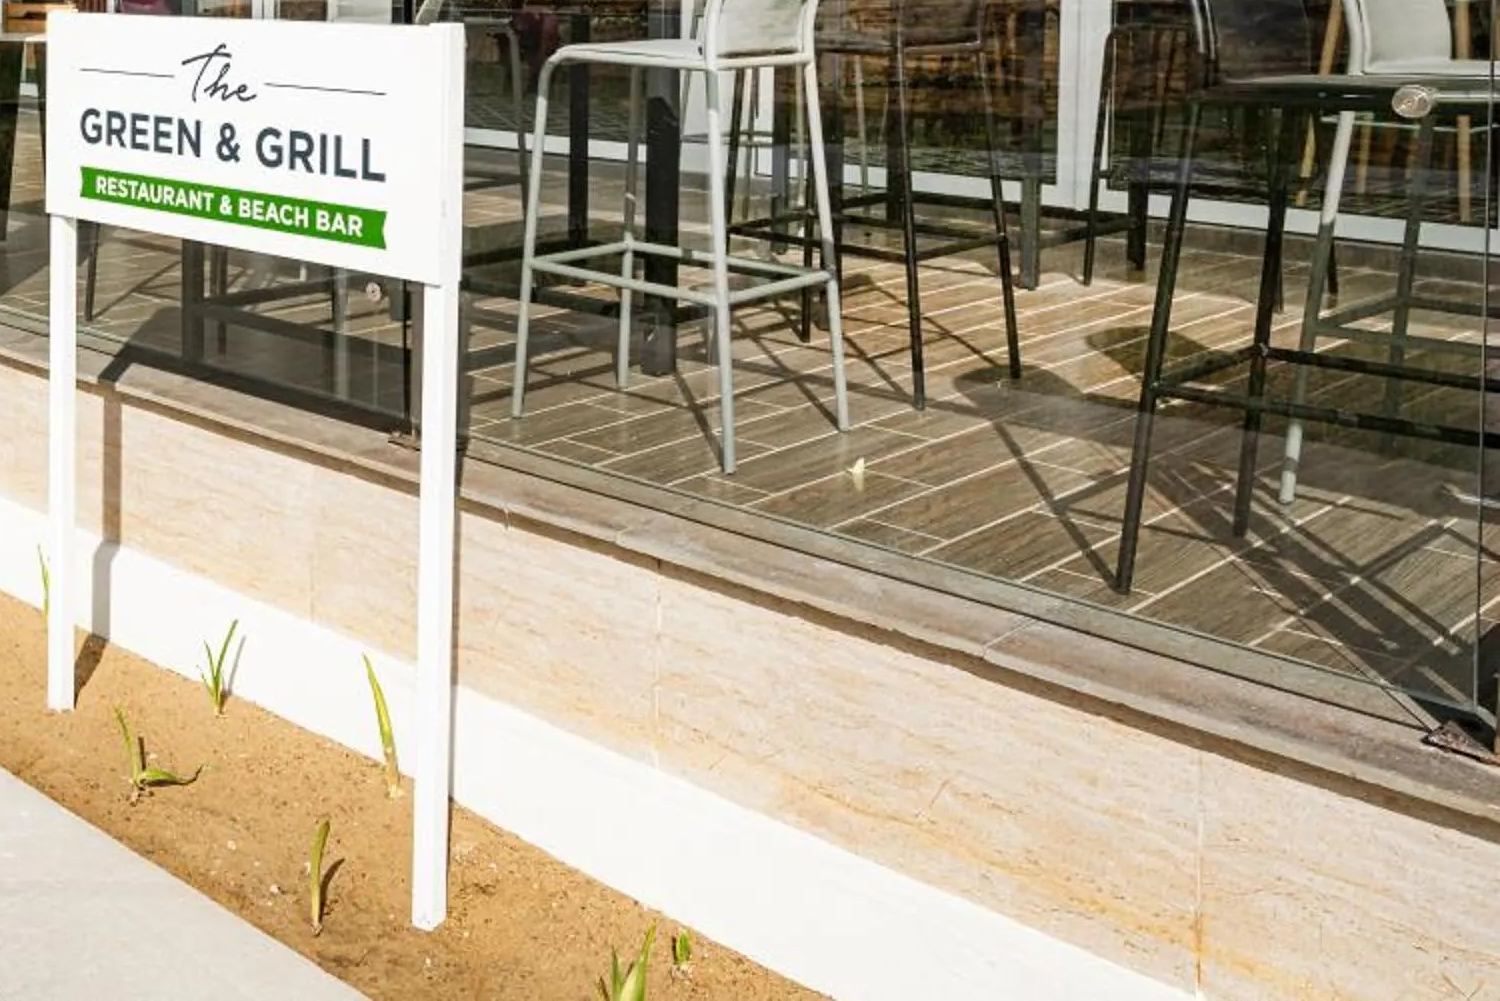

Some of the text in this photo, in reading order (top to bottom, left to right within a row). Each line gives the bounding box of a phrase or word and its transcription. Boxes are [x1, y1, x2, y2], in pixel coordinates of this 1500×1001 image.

[182, 44, 257, 102] The
[80, 108, 387, 183] GREEN & GRILL
[95, 174, 363, 238] RESTAURANT & BEACH BAR
